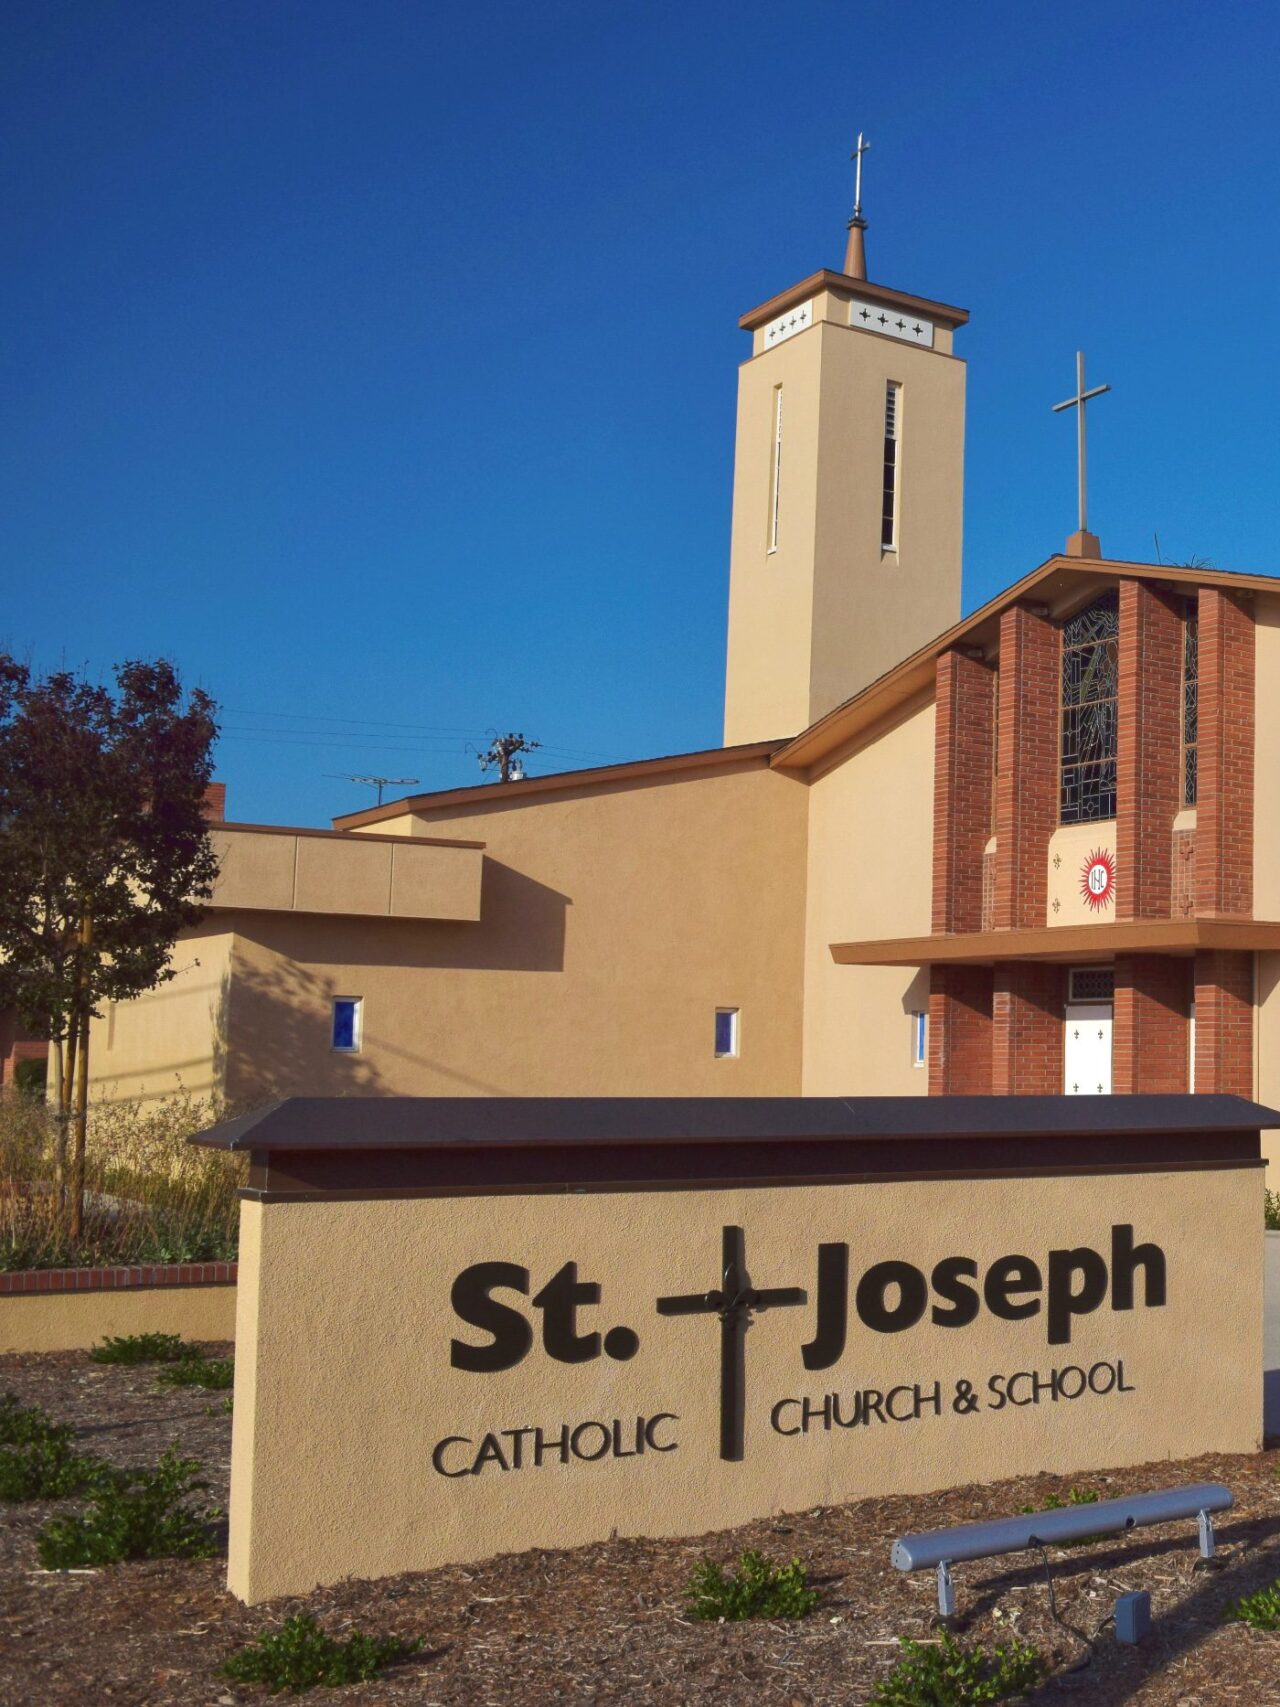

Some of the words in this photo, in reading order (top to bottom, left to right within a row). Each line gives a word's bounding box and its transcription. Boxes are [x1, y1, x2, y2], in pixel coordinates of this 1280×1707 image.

[451, 1262, 640, 1374] St.
[801, 1224, 1167, 1371] Joseph
[432, 1412, 679, 1478] CATHOLIC
[770, 1381, 941, 1436] CHURCH
[953, 1380, 980, 1415] &
[987, 1361, 1135, 1410] SCHOOL
